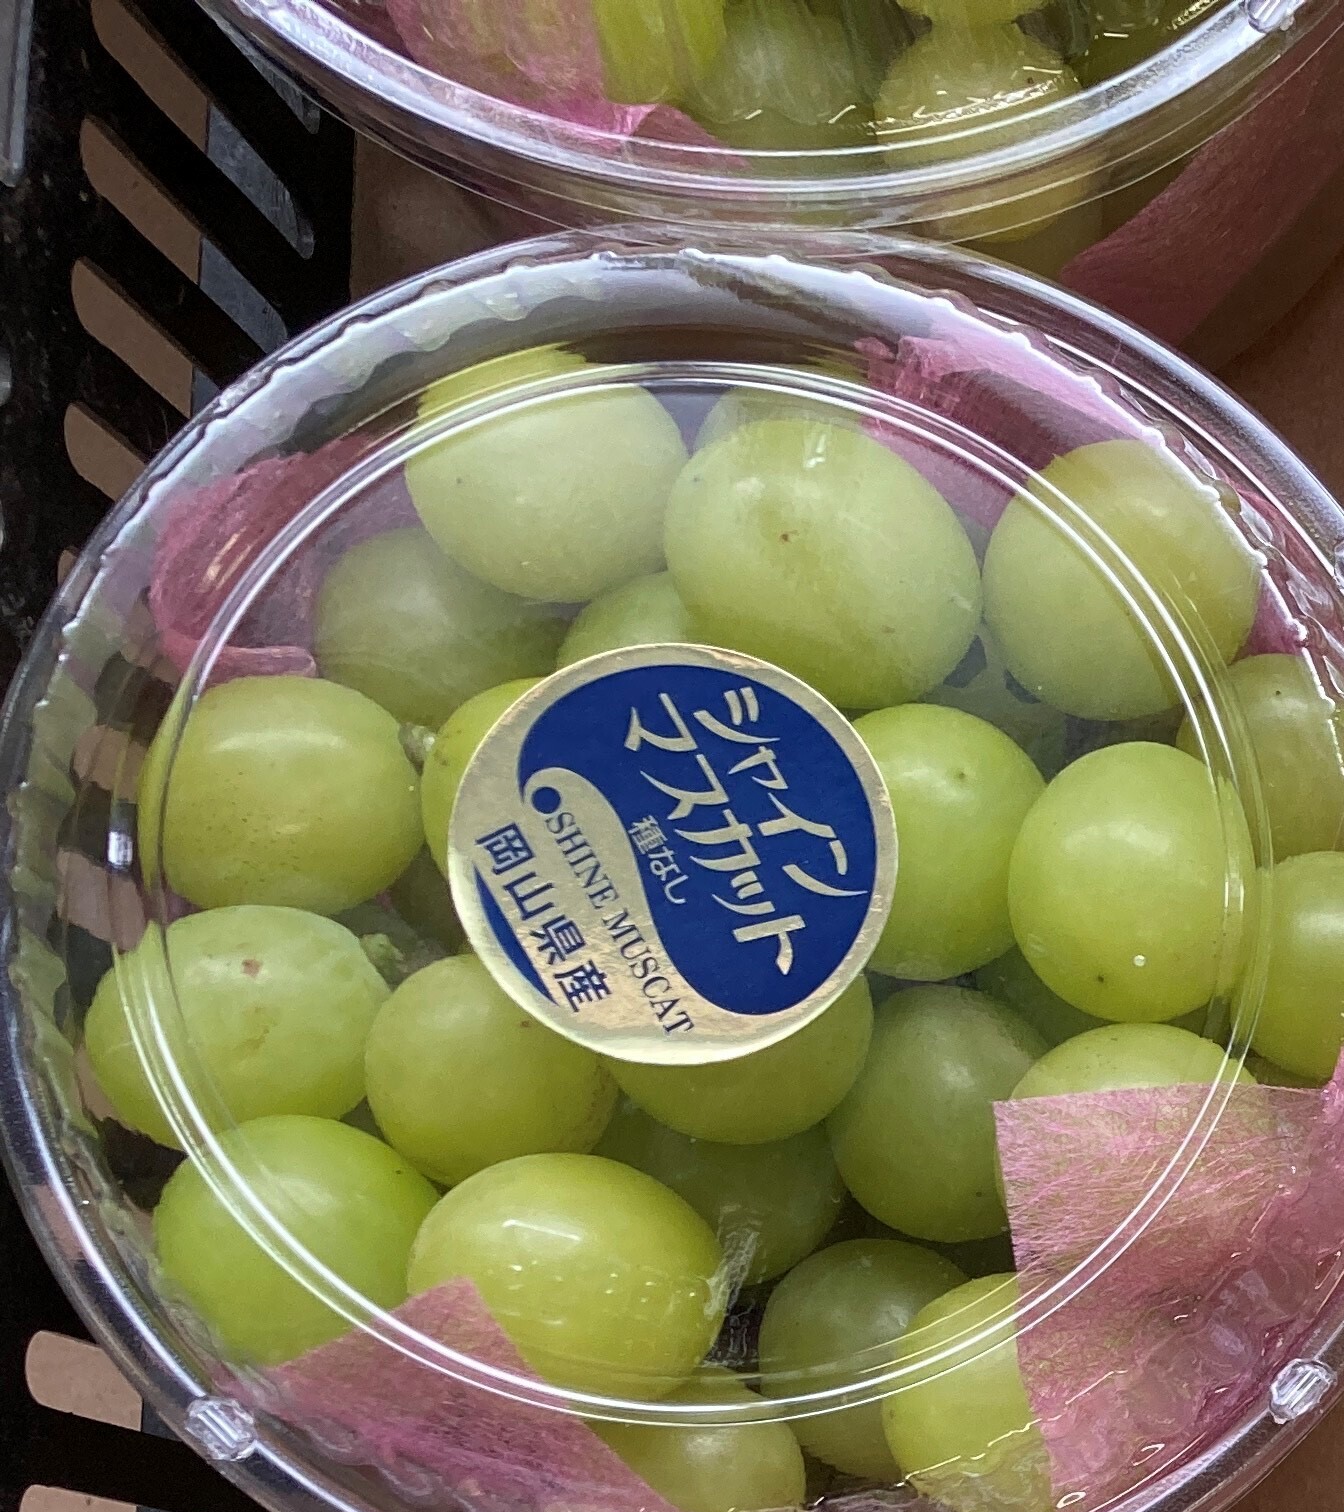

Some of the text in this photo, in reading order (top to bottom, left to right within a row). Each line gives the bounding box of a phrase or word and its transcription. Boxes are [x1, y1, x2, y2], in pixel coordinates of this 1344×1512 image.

[624, 693, 806, 976] マスカット
[629, 816, 686, 905] 種なし
[694, 686, 868, 897] シャイン
[474, 823, 612, 1014] 岡山県産
[544, 811, 695, 1034] SHINE MUSCAT
